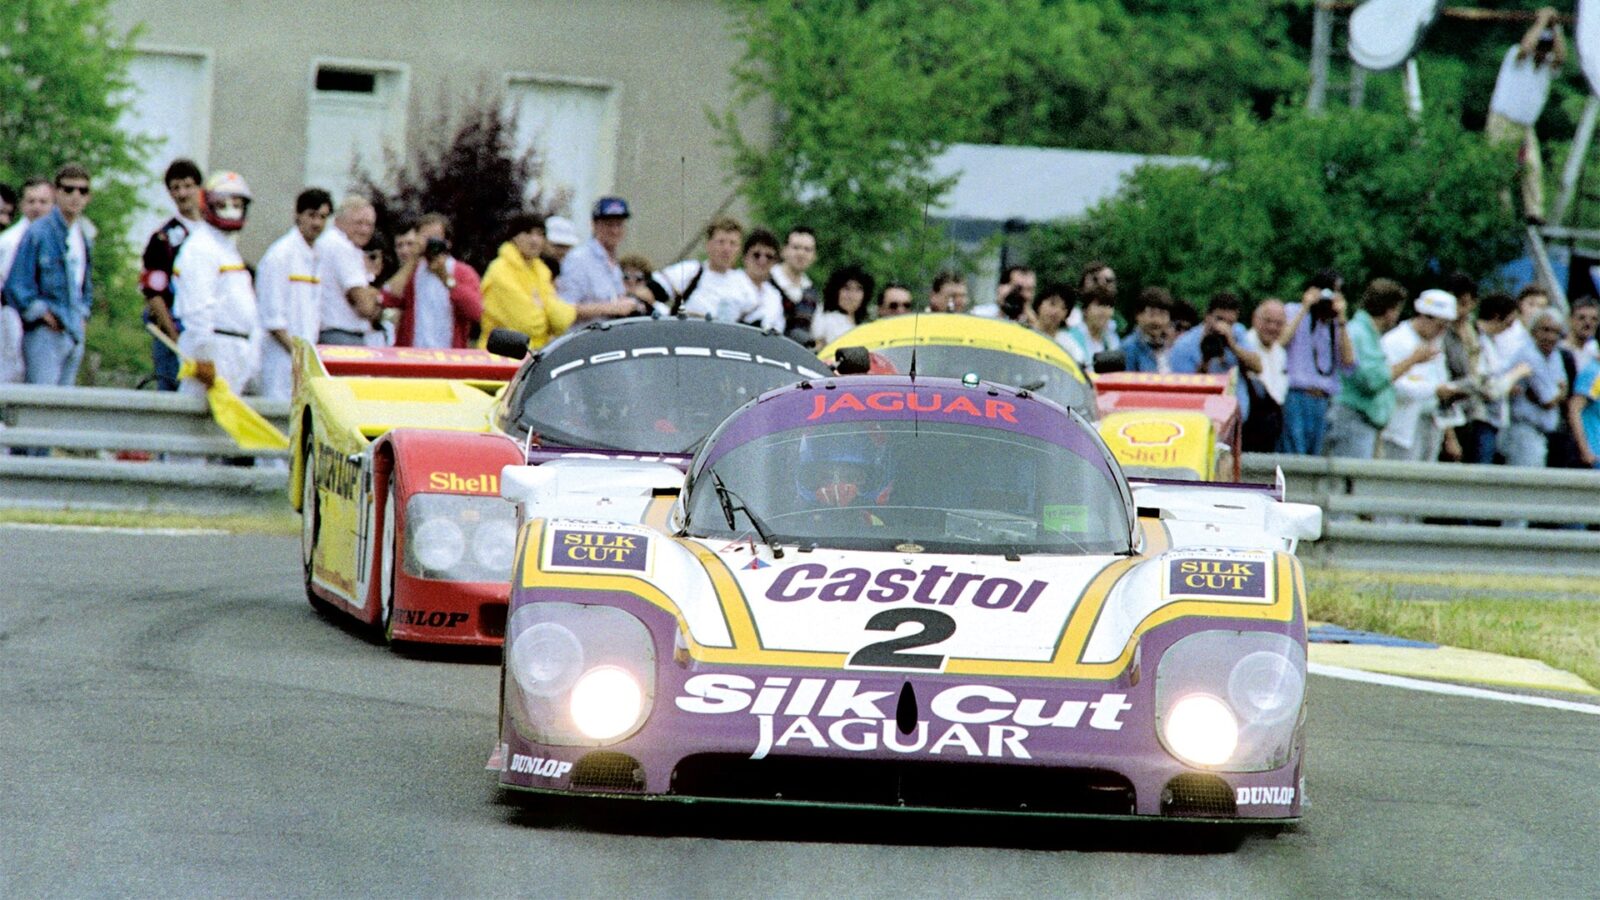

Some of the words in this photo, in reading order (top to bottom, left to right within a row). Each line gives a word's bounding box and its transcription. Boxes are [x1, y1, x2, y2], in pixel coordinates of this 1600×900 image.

[807, 391, 1019, 424] JAGUAR
[429, 471, 498, 493] Shell
[563, 533, 637, 549] SILK
[567, 545, 630, 562] CUT
[1180, 561, 1255, 576] SILK
[765, 563, 1049, 613] Castrol
[1185, 573, 1248, 590] CUT
[849, 606, 957, 670] 2
[675, 673, 895, 719] Silk
[930, 684, 1133, 731] Cut
[749, 715, 1032, 760] JAGUAR
[510, 753, 573, 779] DUNLOP
[1235, 786, 1295, 806] DUNLOP
